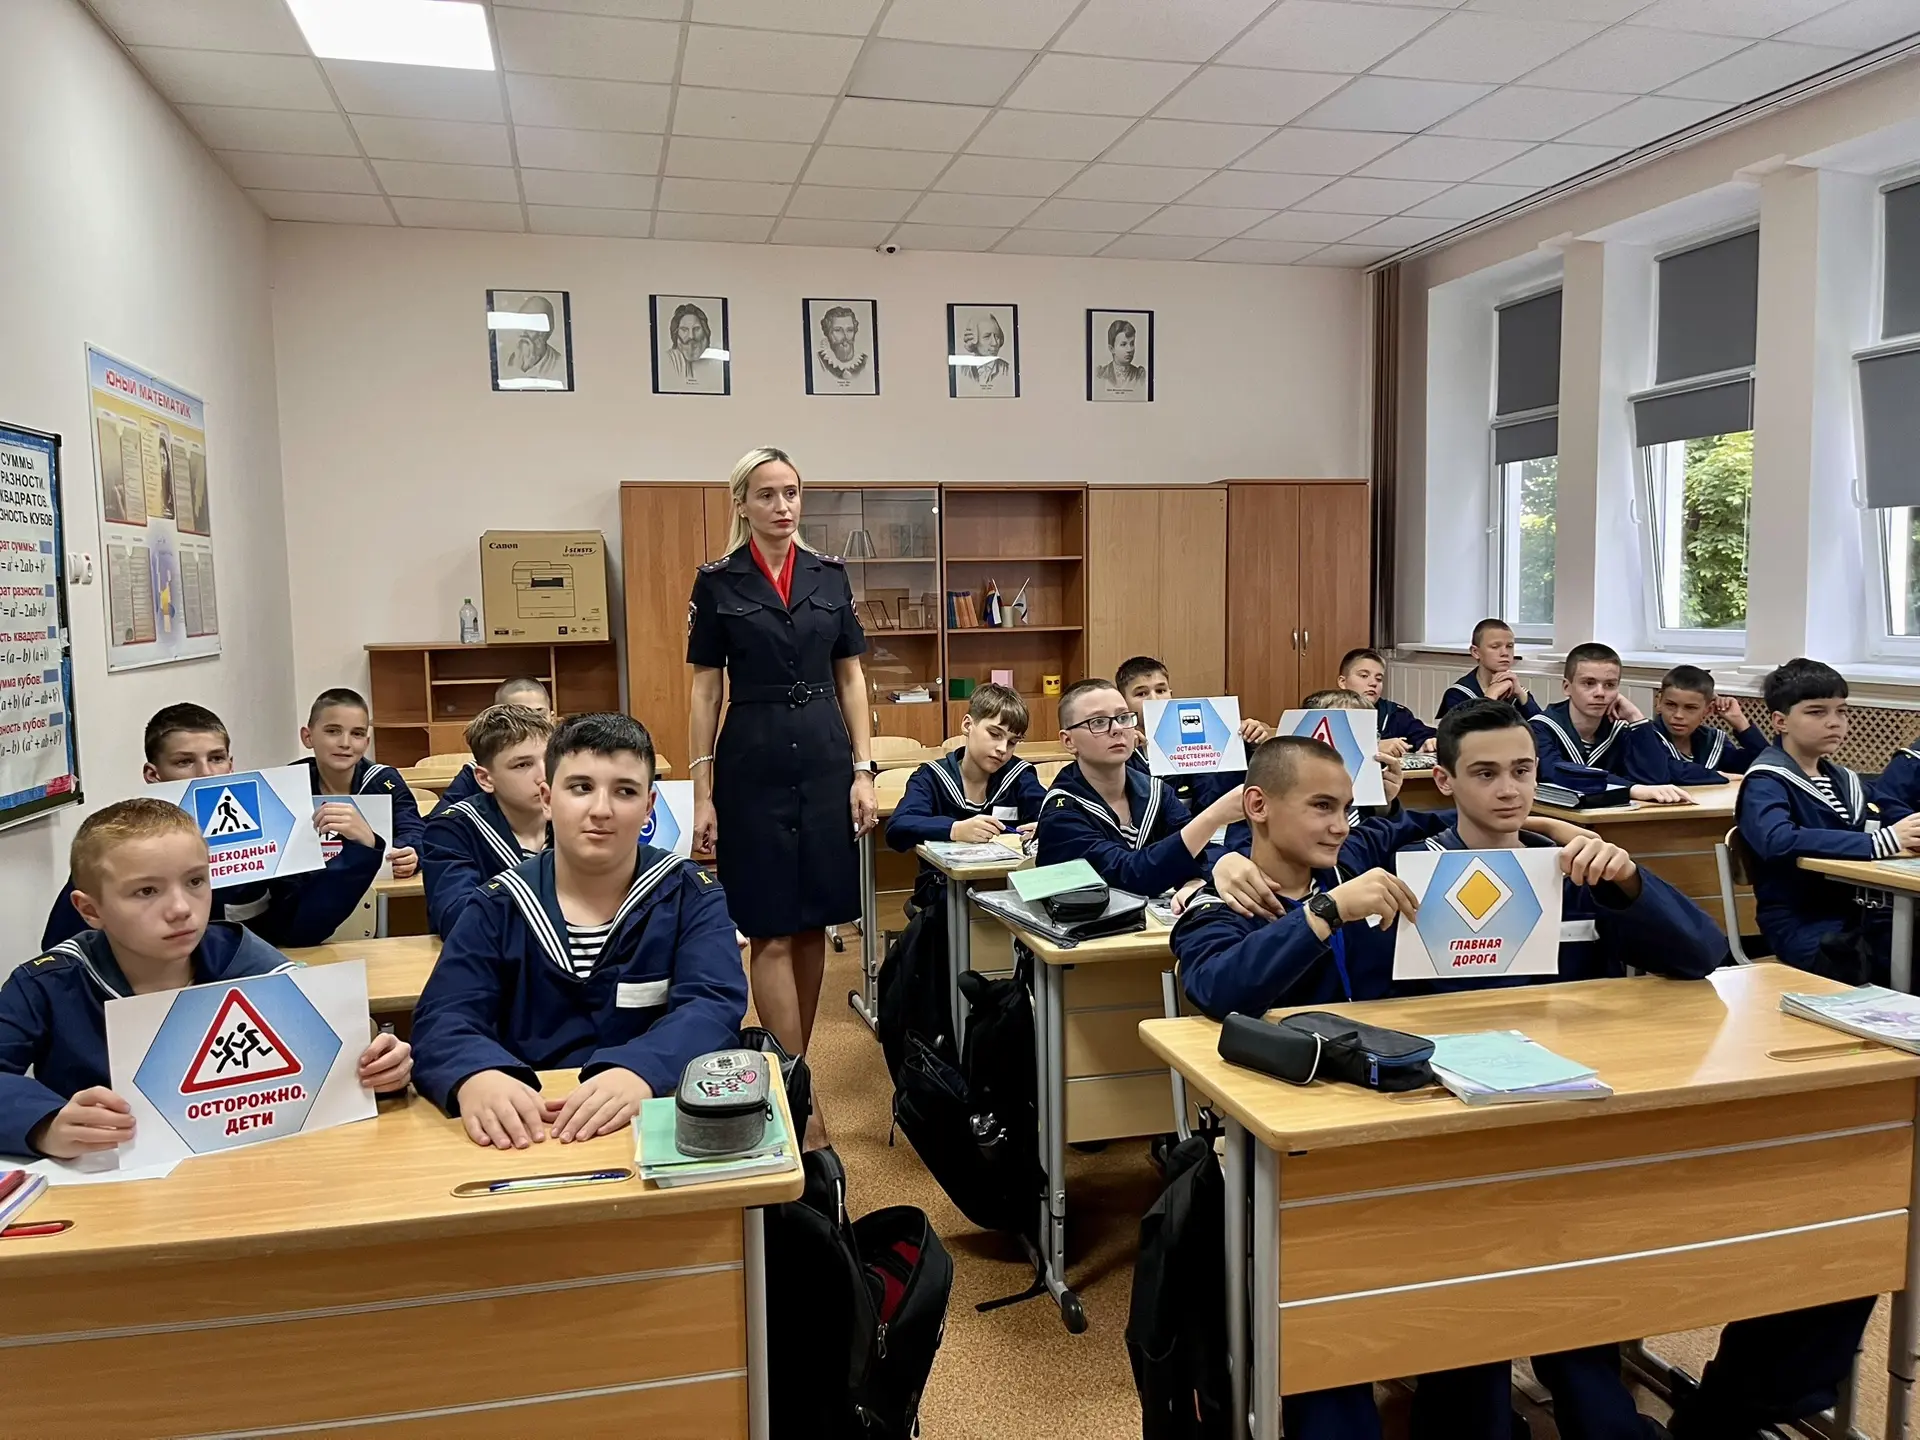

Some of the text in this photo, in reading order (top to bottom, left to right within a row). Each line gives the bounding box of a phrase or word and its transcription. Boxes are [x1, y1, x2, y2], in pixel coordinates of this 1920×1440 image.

[105, 368, 192, 419] ЮНЫЙ МАТЕМАТИК
[488, 542, 519, 550] Canon
[1176, 744, 1212, 752] ОСТАНОВКА
[1169, 752, 1221, 761] ОБЩЕСТВЕННОГО
[211, 860, 265, 877] ПЕРЕХОД
[1449, 938, 1503, 951] ГЛАВНАЯ
[1452, 953, 1498, 967] ДОРОГА
[187, 1085, 307, 1119] ОСТОРОЖНО,
[225, 1111, 274, 1136] ДЕТИ
